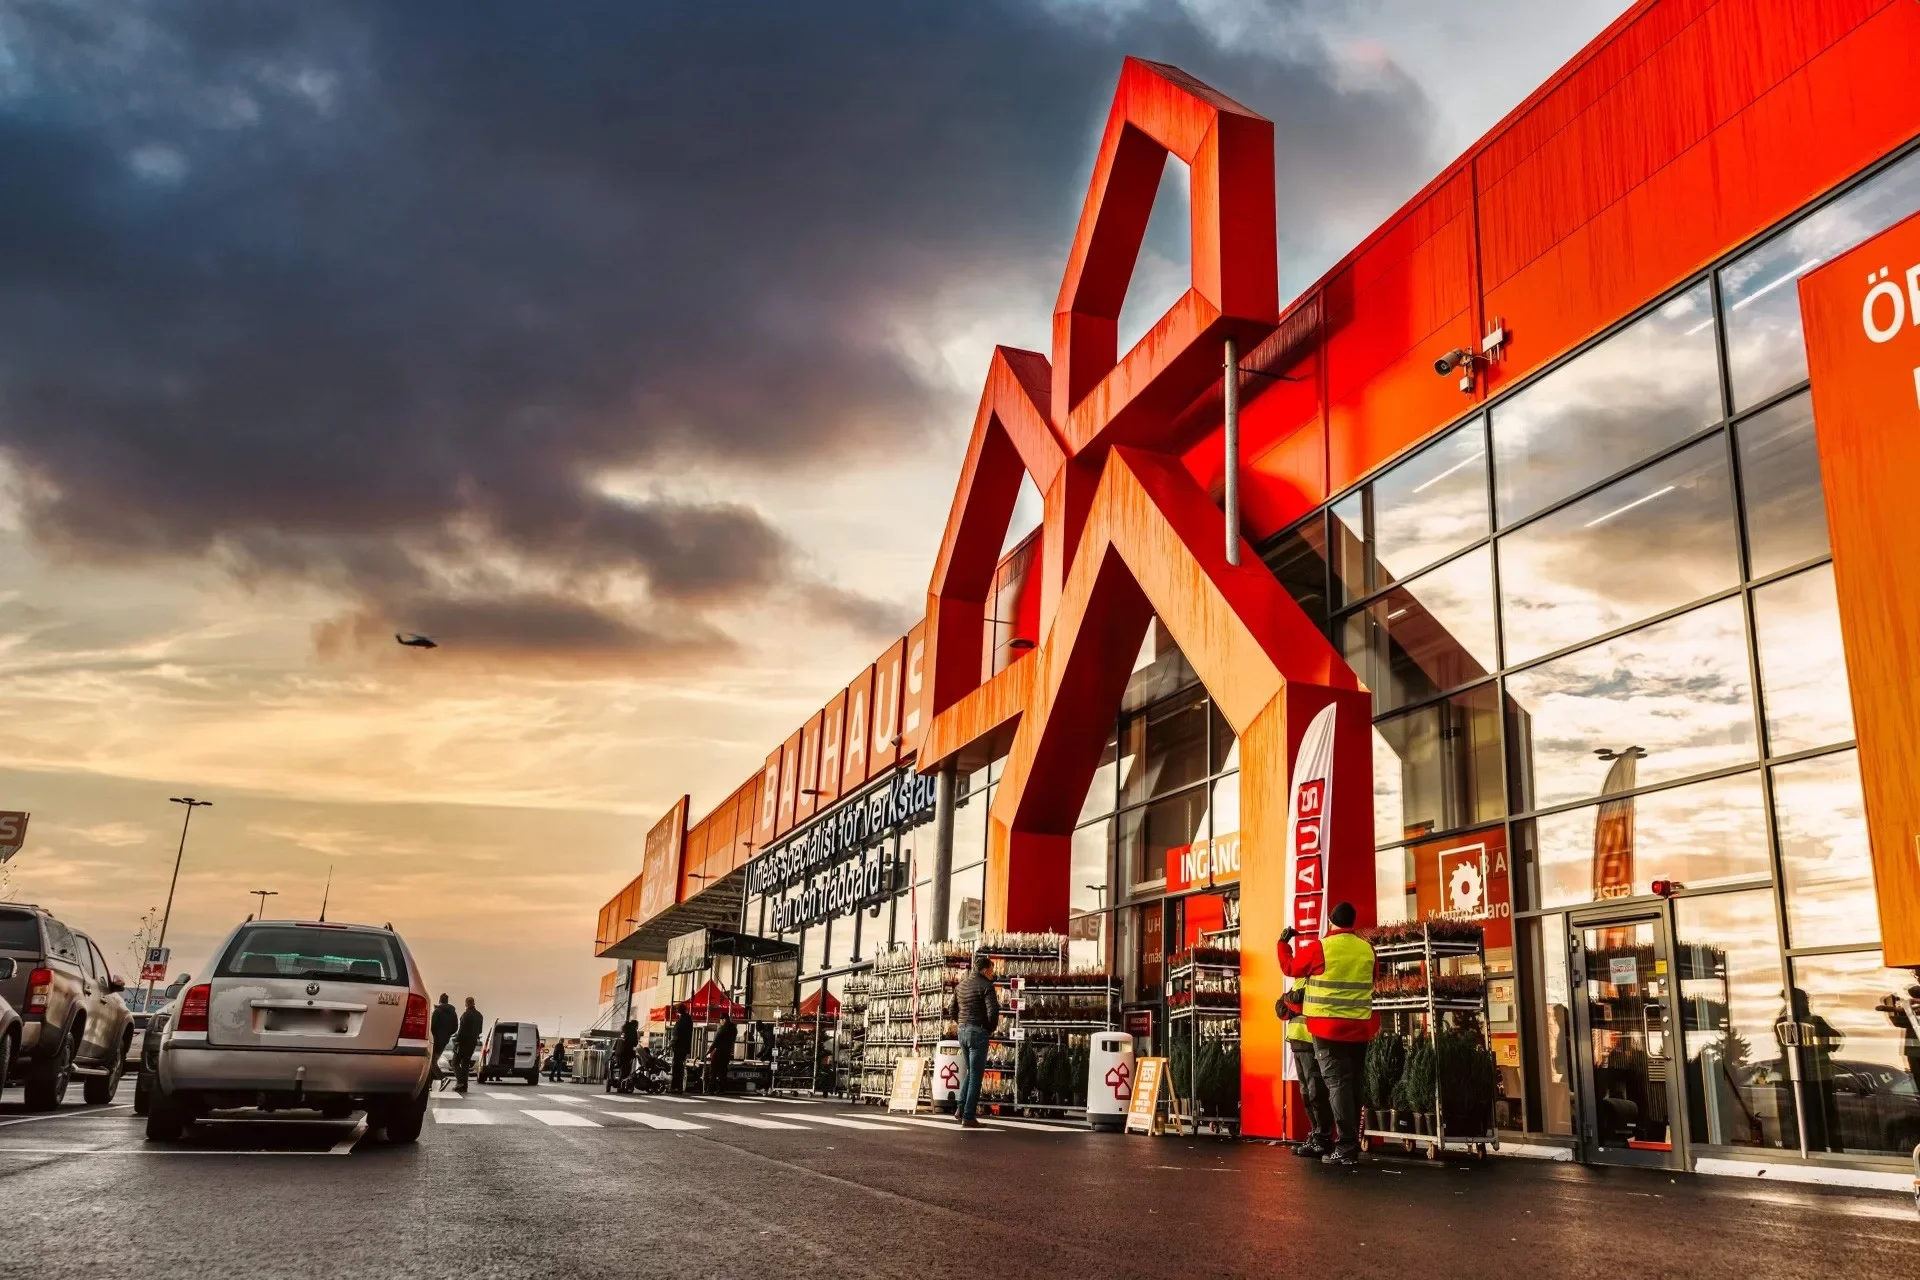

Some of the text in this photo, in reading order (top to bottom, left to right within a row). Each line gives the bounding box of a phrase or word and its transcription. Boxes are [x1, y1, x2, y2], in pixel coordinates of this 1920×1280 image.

[749, 853, 778, 896] Umeås
[781, 821, 836, 883] specialist
[839, 803, 862, 850] för
[771, 845, 881, 932] hem och trädgård
